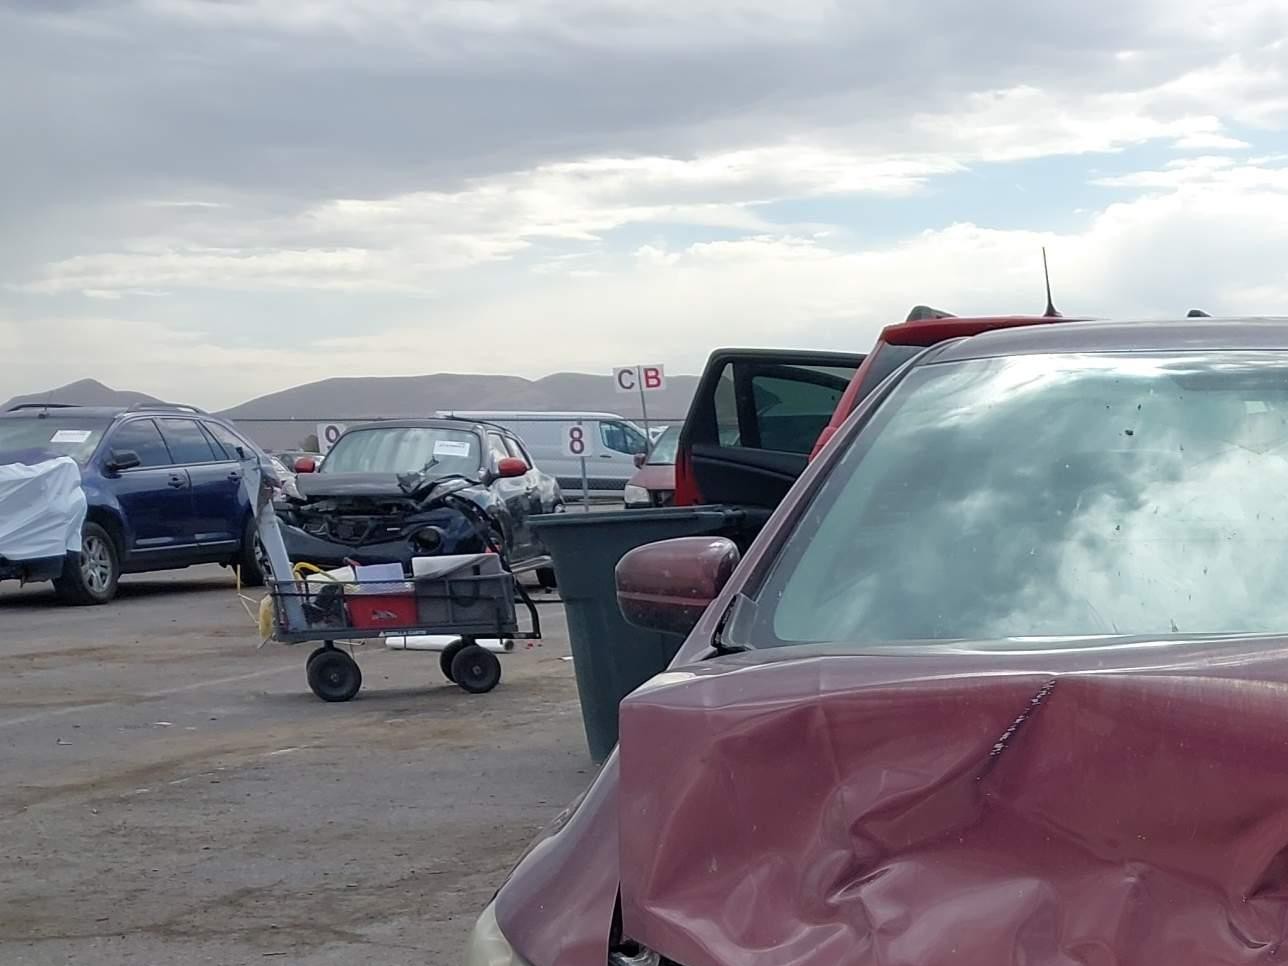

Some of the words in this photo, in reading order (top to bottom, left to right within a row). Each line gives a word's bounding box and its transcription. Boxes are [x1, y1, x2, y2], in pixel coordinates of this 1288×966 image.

[617, 369, 634, 389] C
[644, 367, 661, 388] B
[569, 427, 584, 454] 8
